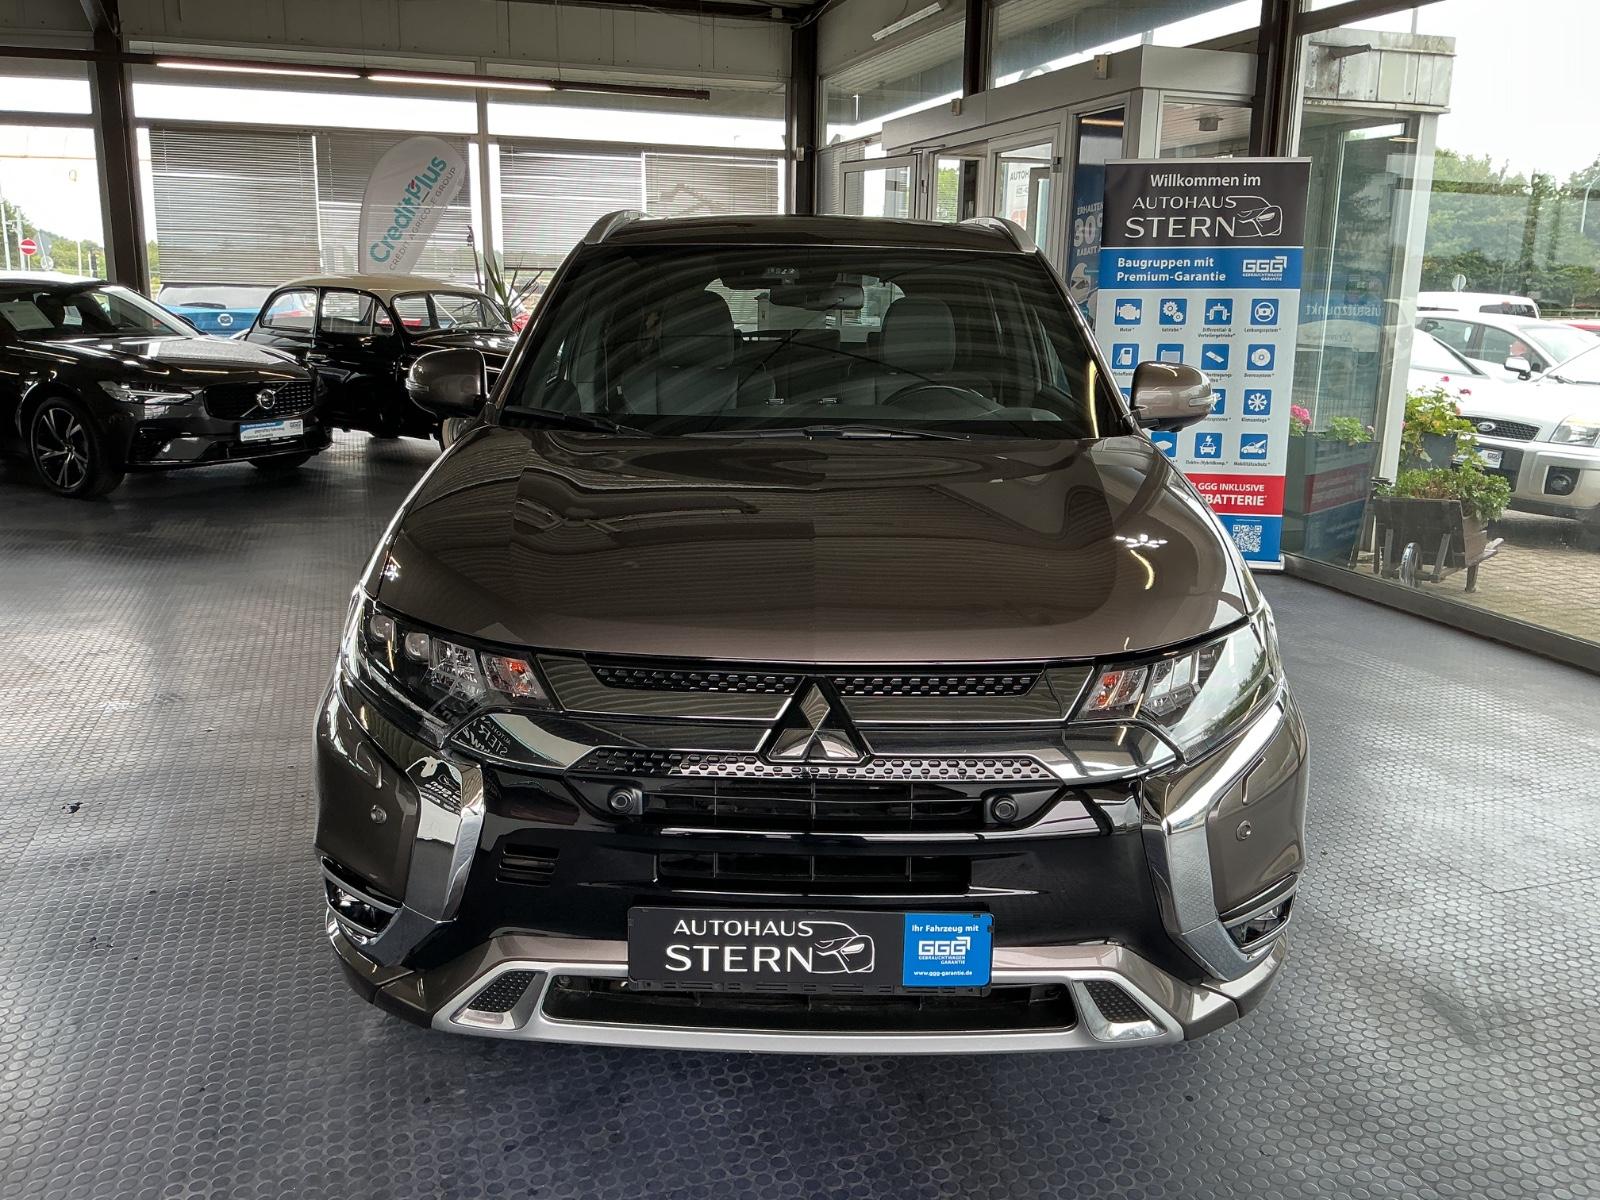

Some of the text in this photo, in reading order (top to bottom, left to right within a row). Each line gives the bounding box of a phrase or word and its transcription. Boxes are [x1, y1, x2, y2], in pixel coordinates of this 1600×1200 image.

[1150, 174, 1261, 188] Willkommen im
[409, 196, 438, 240] AGRICOE
[435, 167, 456, 198] GROUP
[1132, 196, 1237, 210] AUTOHAUS
[1125, 216, 1236, 238] STERN
[1117, 257, 1214, 270] Baugruppen mit
[1242, 257, 1286, 273] GGG
[1116, 271, 1226, 283] Premium-Garantie
[1197, 482, 1218, 491] GGG
[1219, 483, 1265, 492] INKLUSIVE
[673, 919, 814, 937] AUTOHAUS
[911, 924, 980, 933] Ihr Fahrzeug mit
[918, 938, 968, 956] GGG
[665, 944, 813, 973] STERN
